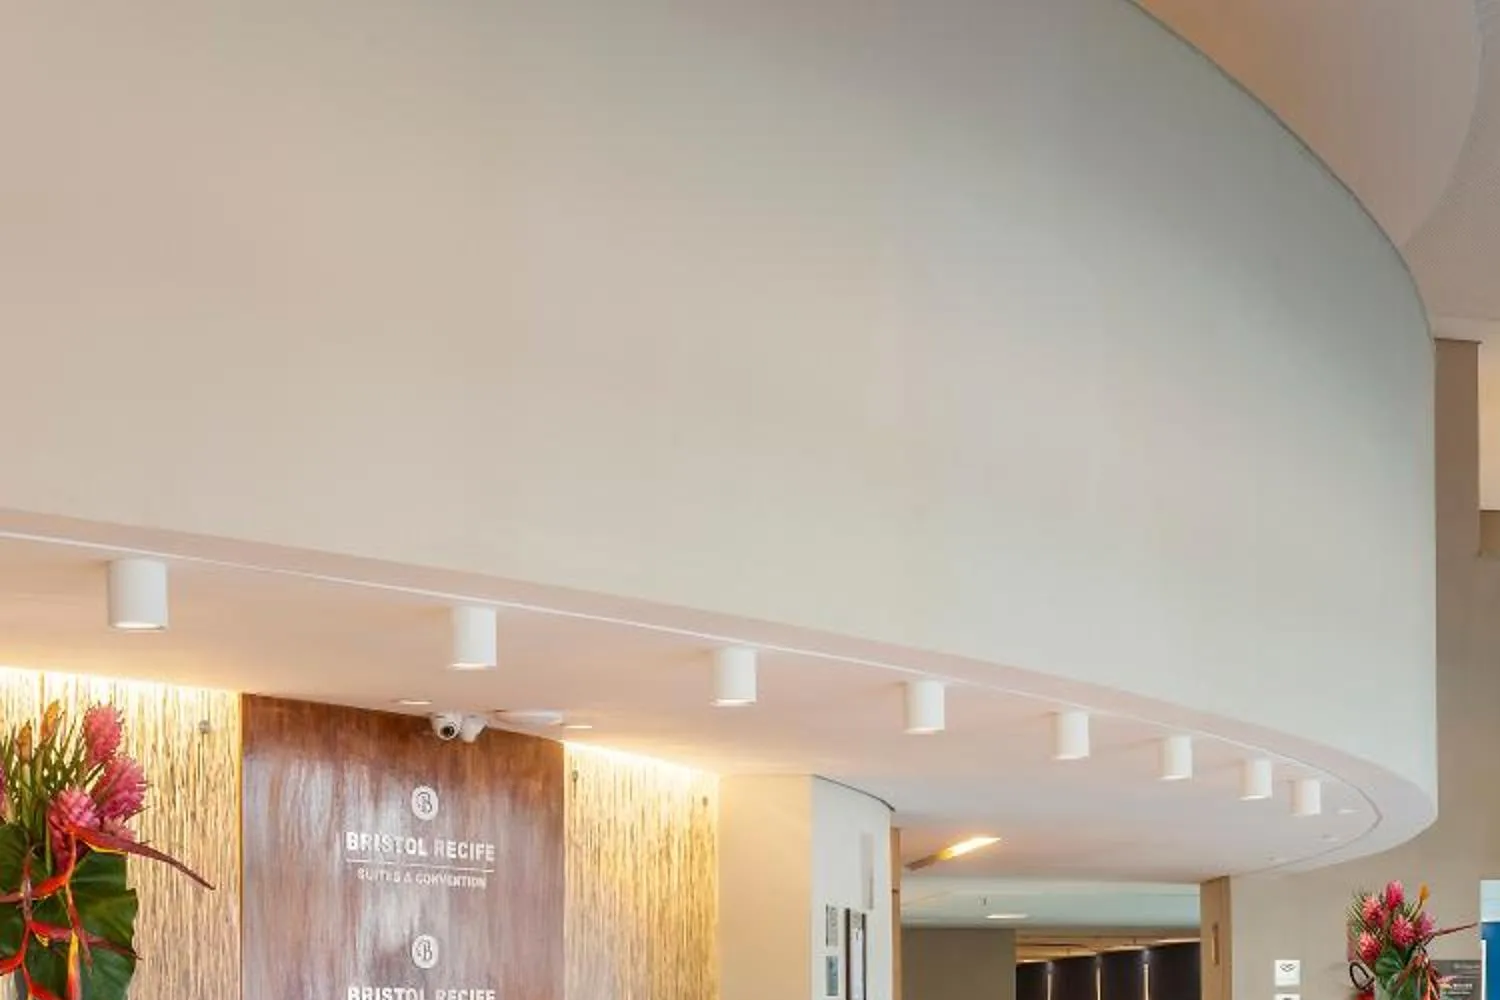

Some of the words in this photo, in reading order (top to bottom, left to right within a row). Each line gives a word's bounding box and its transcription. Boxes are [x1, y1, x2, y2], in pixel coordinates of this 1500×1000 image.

[345, 831, 428, 857] BRISTOL
[433, 839, 495, 861] RECIFE
[415, 873, 487, 890] CONVENTION
